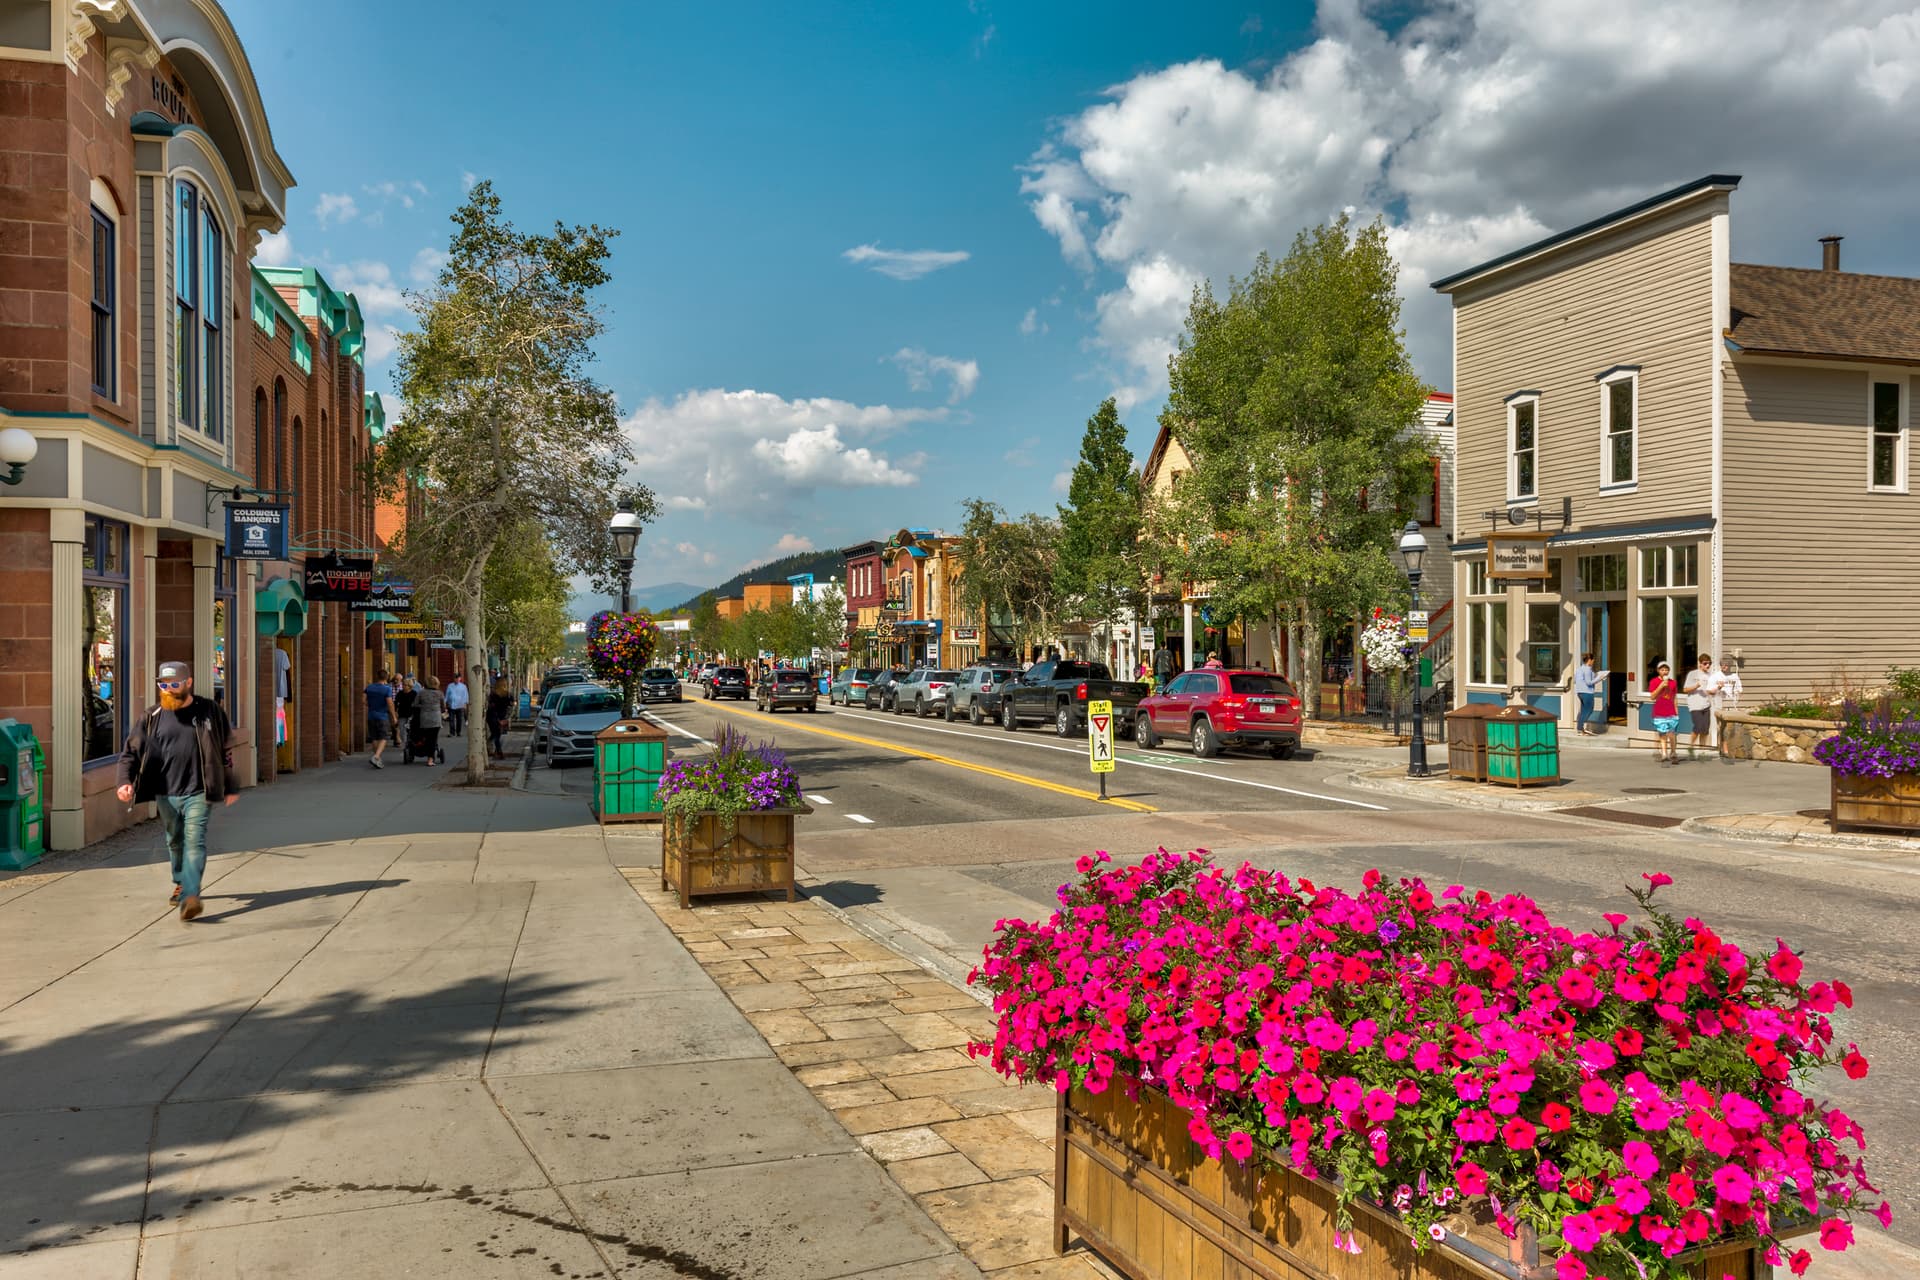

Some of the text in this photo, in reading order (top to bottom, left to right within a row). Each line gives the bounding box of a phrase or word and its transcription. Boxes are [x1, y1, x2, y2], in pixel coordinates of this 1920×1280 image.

[233, 509, 280, 517] COLDWELL
[234, 516, 273, 524] BANKER
[1512, 545, 1527, 555] Old
[1495, 554, 1543, 563] Masonic Hall
[327, 570, 371, 579] mountain
[327, 578, 371, 590] VIBE
